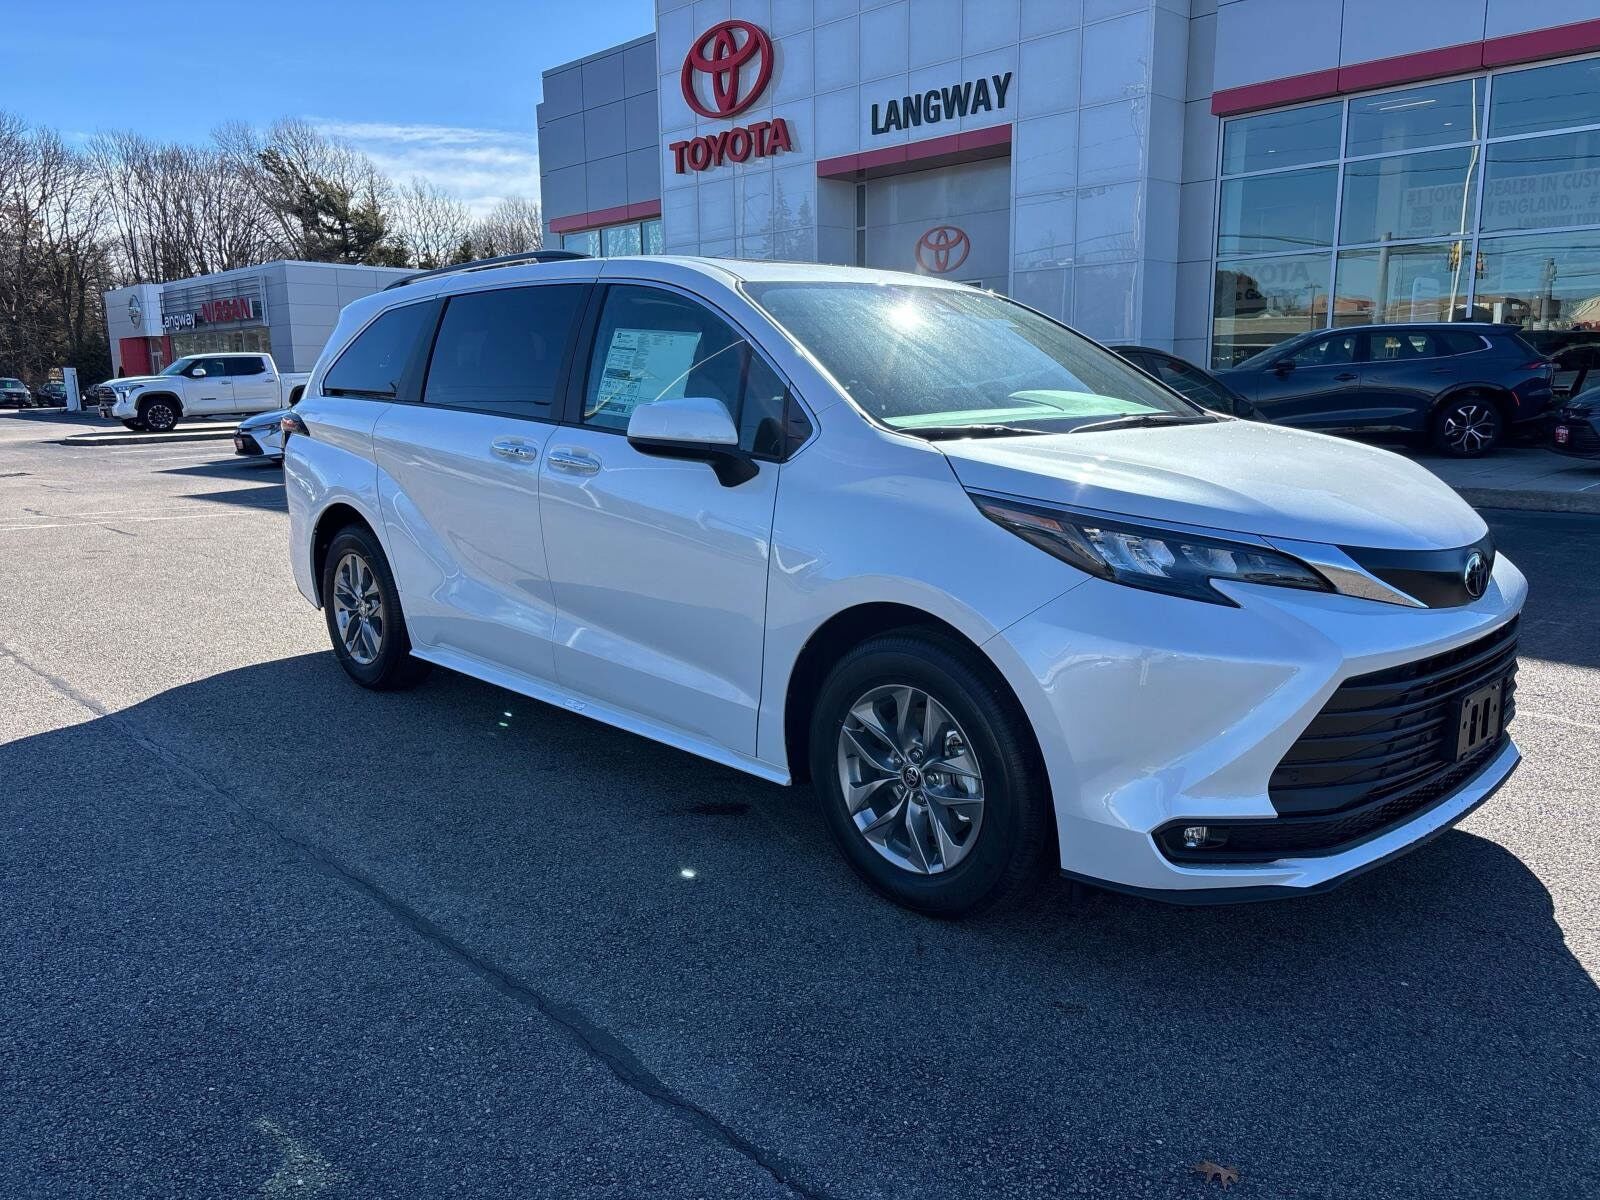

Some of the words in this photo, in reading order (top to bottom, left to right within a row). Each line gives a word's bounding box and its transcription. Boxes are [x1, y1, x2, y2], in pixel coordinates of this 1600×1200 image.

[871, 72, 1012, 135] LANGWAY
[669, 117, 792, 174] TOYOTA
[1541, 174, 1558, 193] IN
[162, 313, 196, 330] Langway
